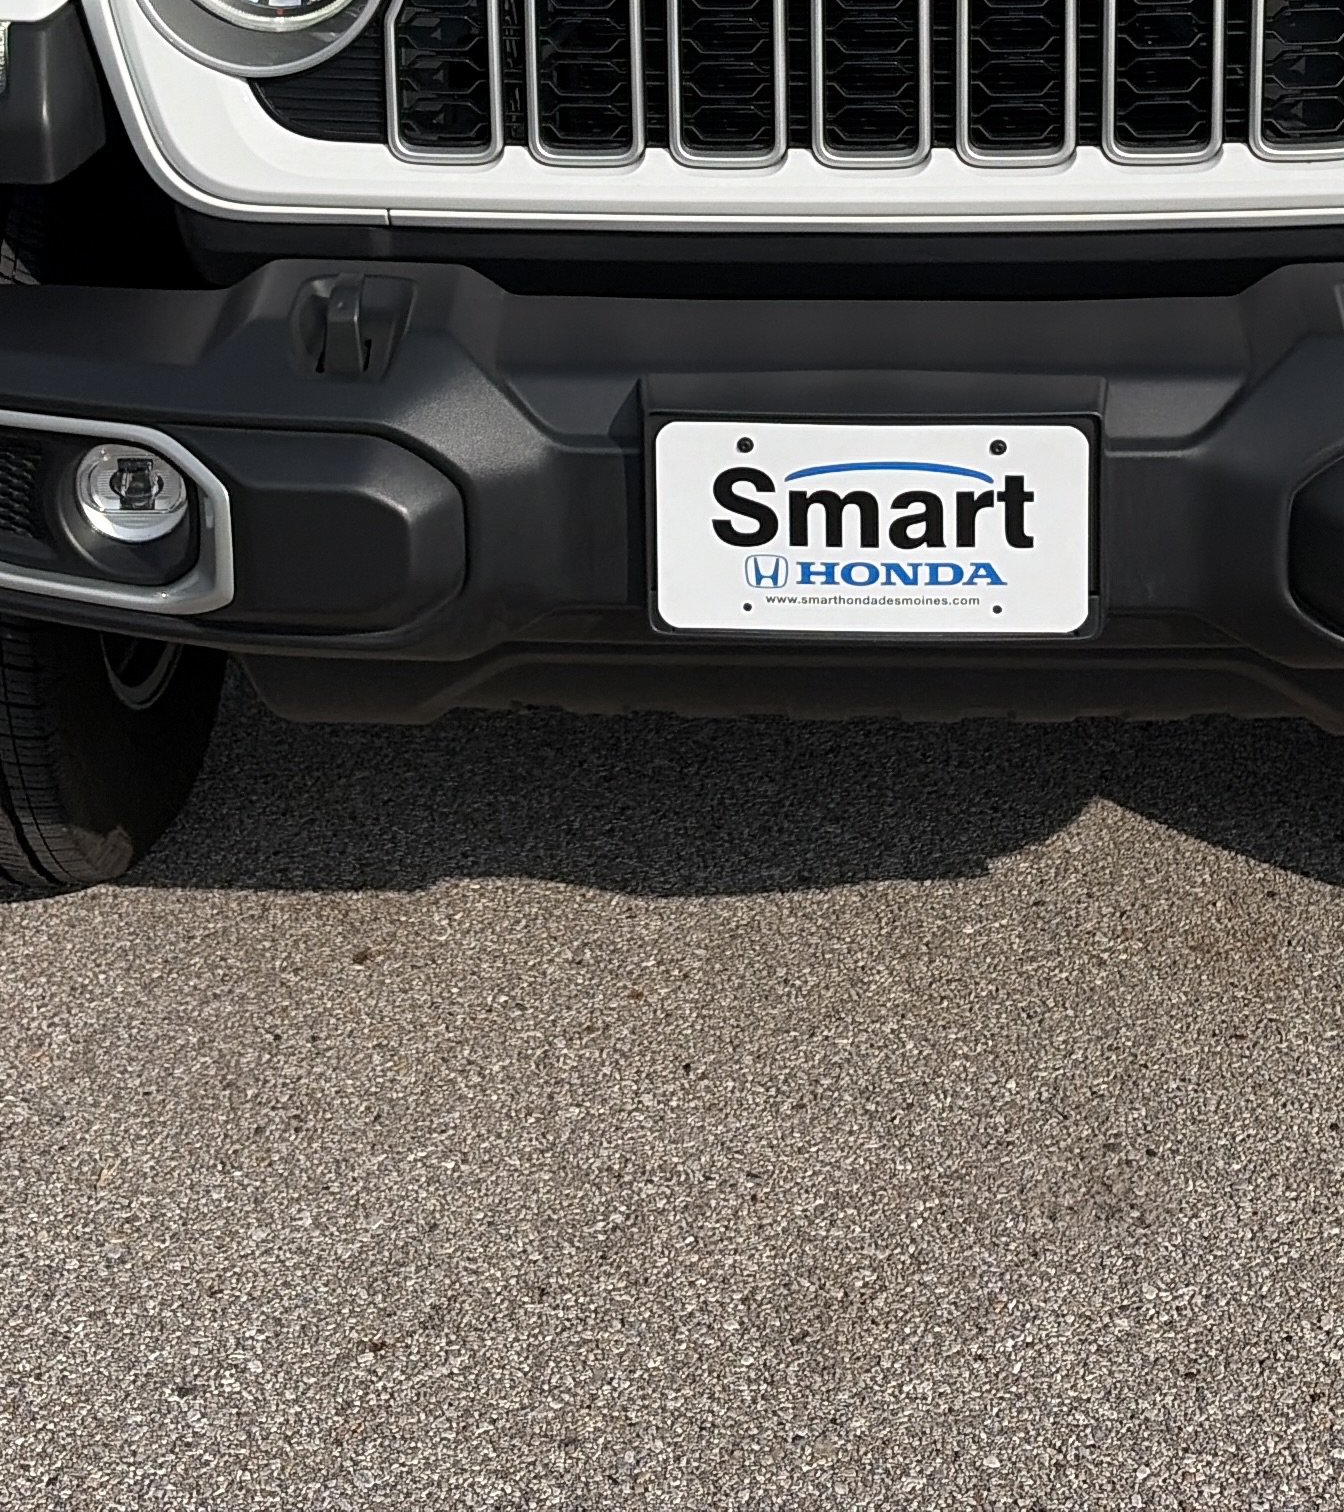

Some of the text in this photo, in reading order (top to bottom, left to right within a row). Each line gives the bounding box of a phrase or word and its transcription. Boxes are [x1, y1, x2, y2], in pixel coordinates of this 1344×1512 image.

[711, 466, 1035, 549] Smart
[795, 561, 1009, 587] HONDA
[765, 594, 981, 607] www.smarthondadesmoines.com
